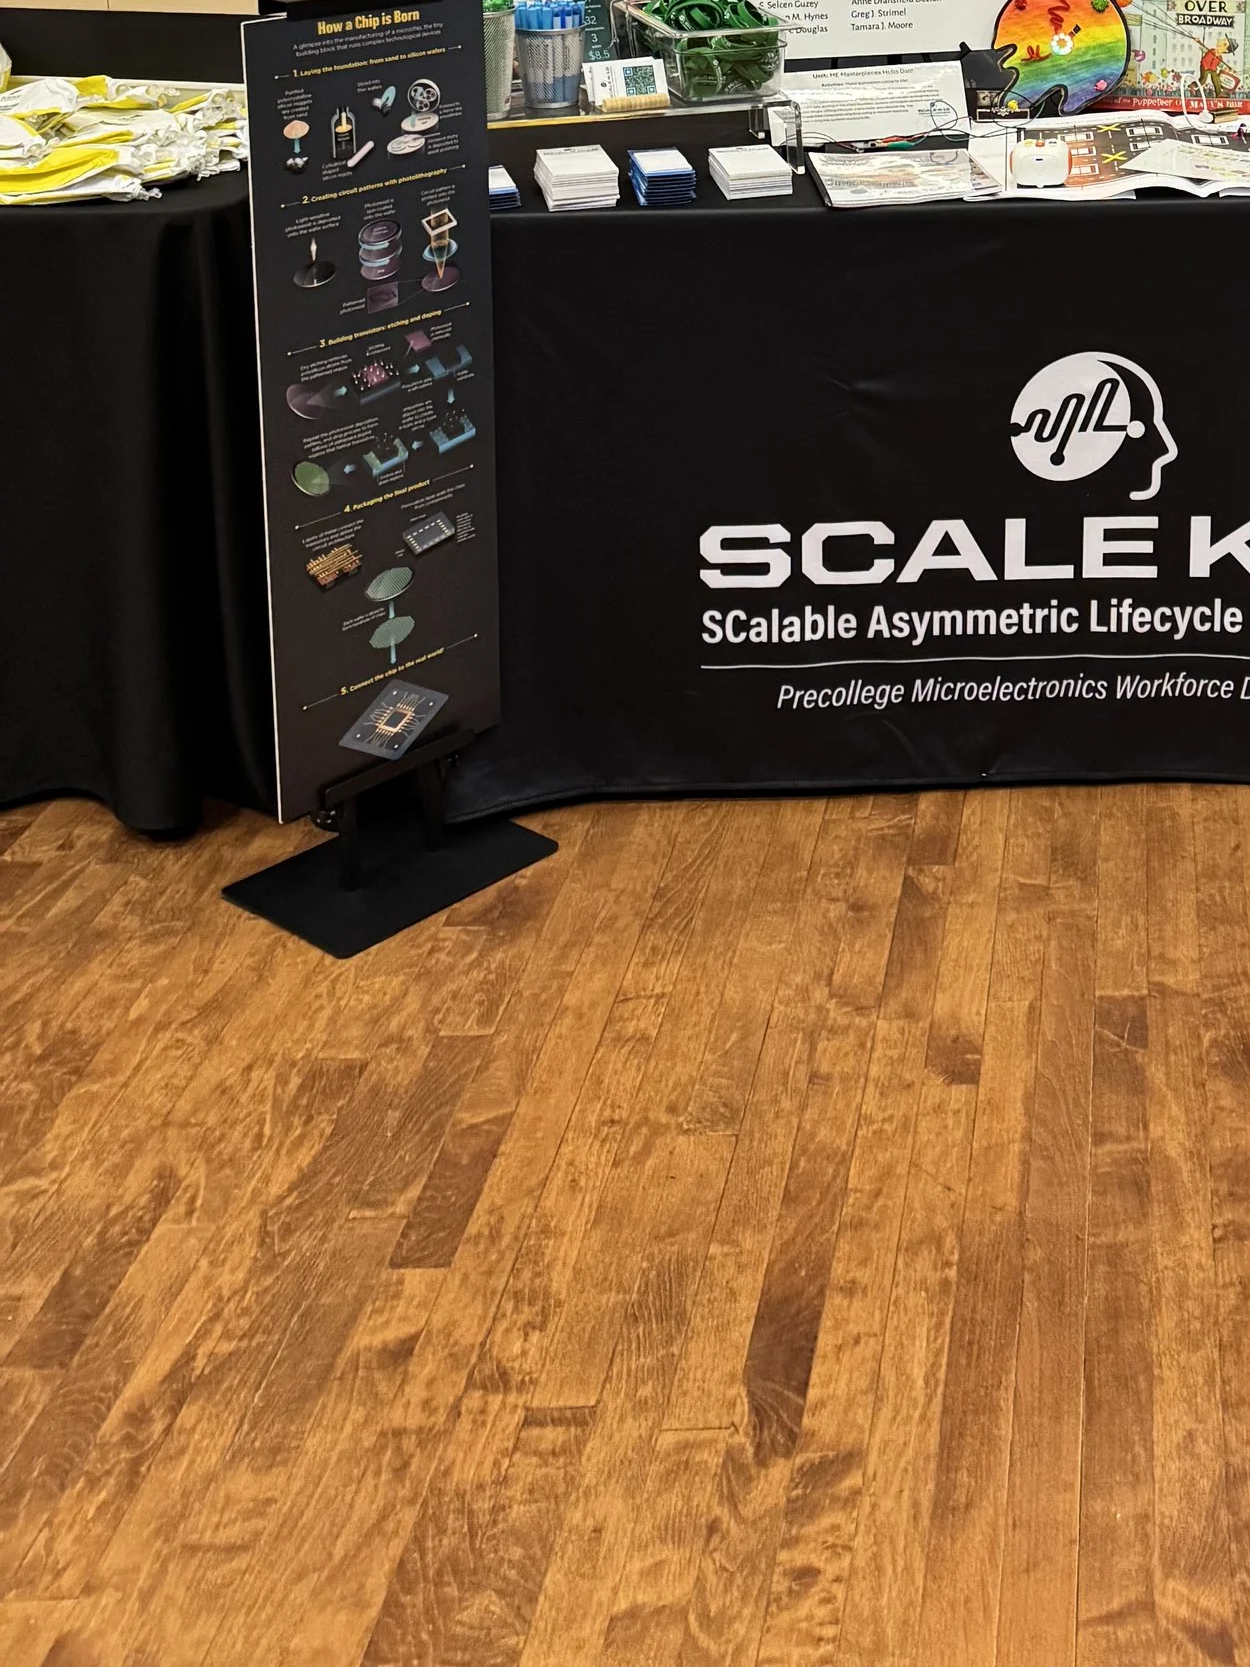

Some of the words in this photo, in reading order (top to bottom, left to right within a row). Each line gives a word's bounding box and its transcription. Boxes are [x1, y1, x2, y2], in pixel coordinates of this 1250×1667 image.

[1179, 15, 1233, 25] BROADWAY
[1184, 0, 1227, 12] OVER
[317, 21, 342, 34] How
[345, 21, 352, 31] a
[355, 15, 380, 29] Chip
[382, 13, 392, 25] is
[394, 10, 420, 24] Born
[293, 69, 300, 78] 1.
[300, 67, 321, 77] Laying
[333, 61, 368, 71] foundation:
[369, 57, 384, 65] from
[407, 50, 426, 59] silicon
[427, 47, 446, 56] wafers
[698, 515, 1160, 591] SCALE
[702, 603, 858, 646] SCalable
[866, 600, 1080, 642] Asymmetric
[1088, 596, 1244, 638] Lifecycle
[776, 678, 905, 711] Precollege
[910, 673, 1109, 705] Microelectronics
[1115, 672, 1234, 702] Workforce
